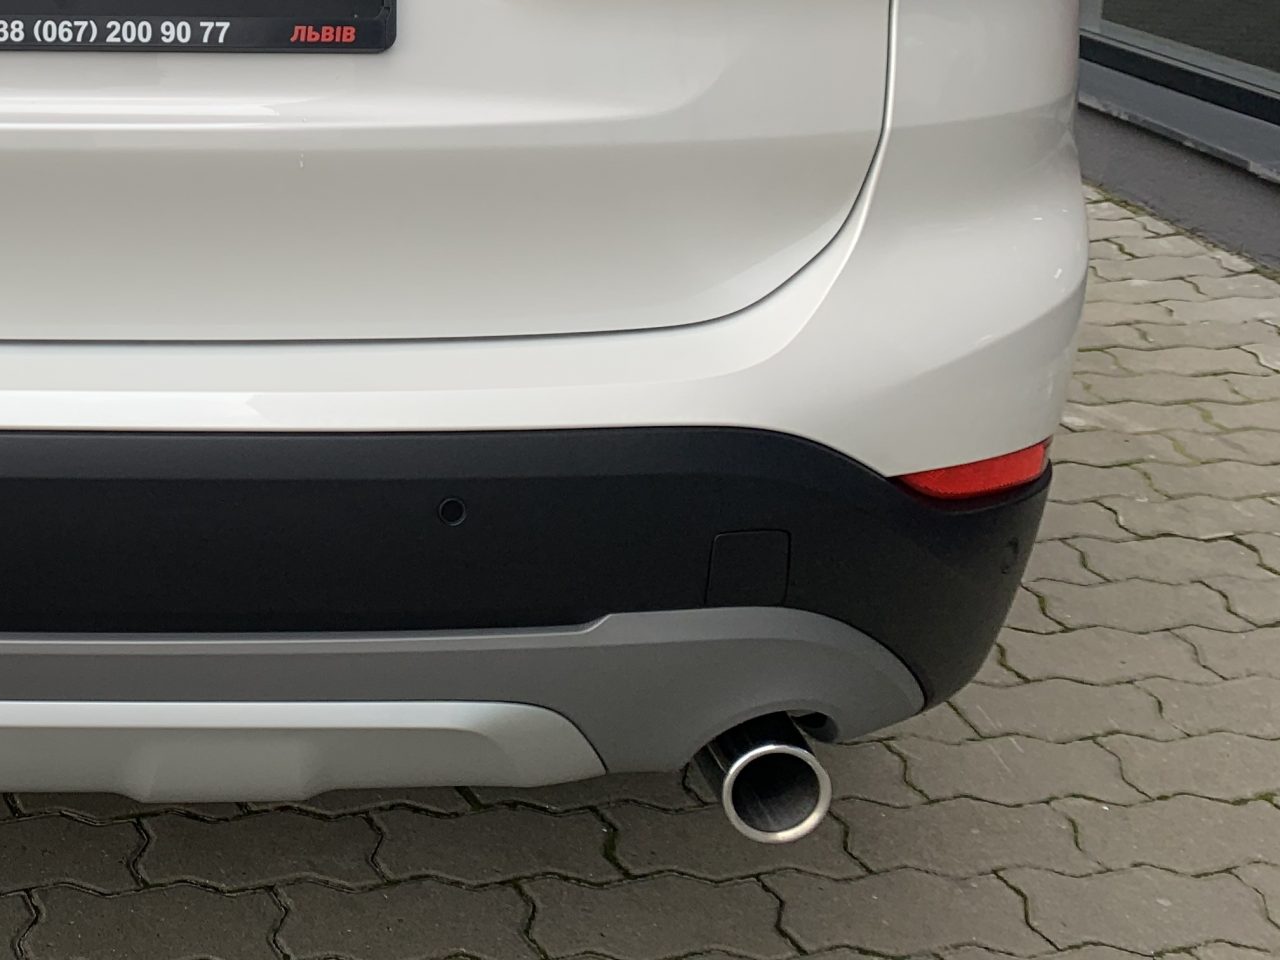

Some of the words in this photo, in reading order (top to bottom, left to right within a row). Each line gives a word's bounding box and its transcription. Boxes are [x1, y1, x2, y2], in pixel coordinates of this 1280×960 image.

[33, 19, 97, 42] (067)
[106, 20, 152, 43] 200
[160, 21, 191, 43] 90
[200, 21, 230, 43] 77
[290, 25, 356, 43] ЛЬВІВ
